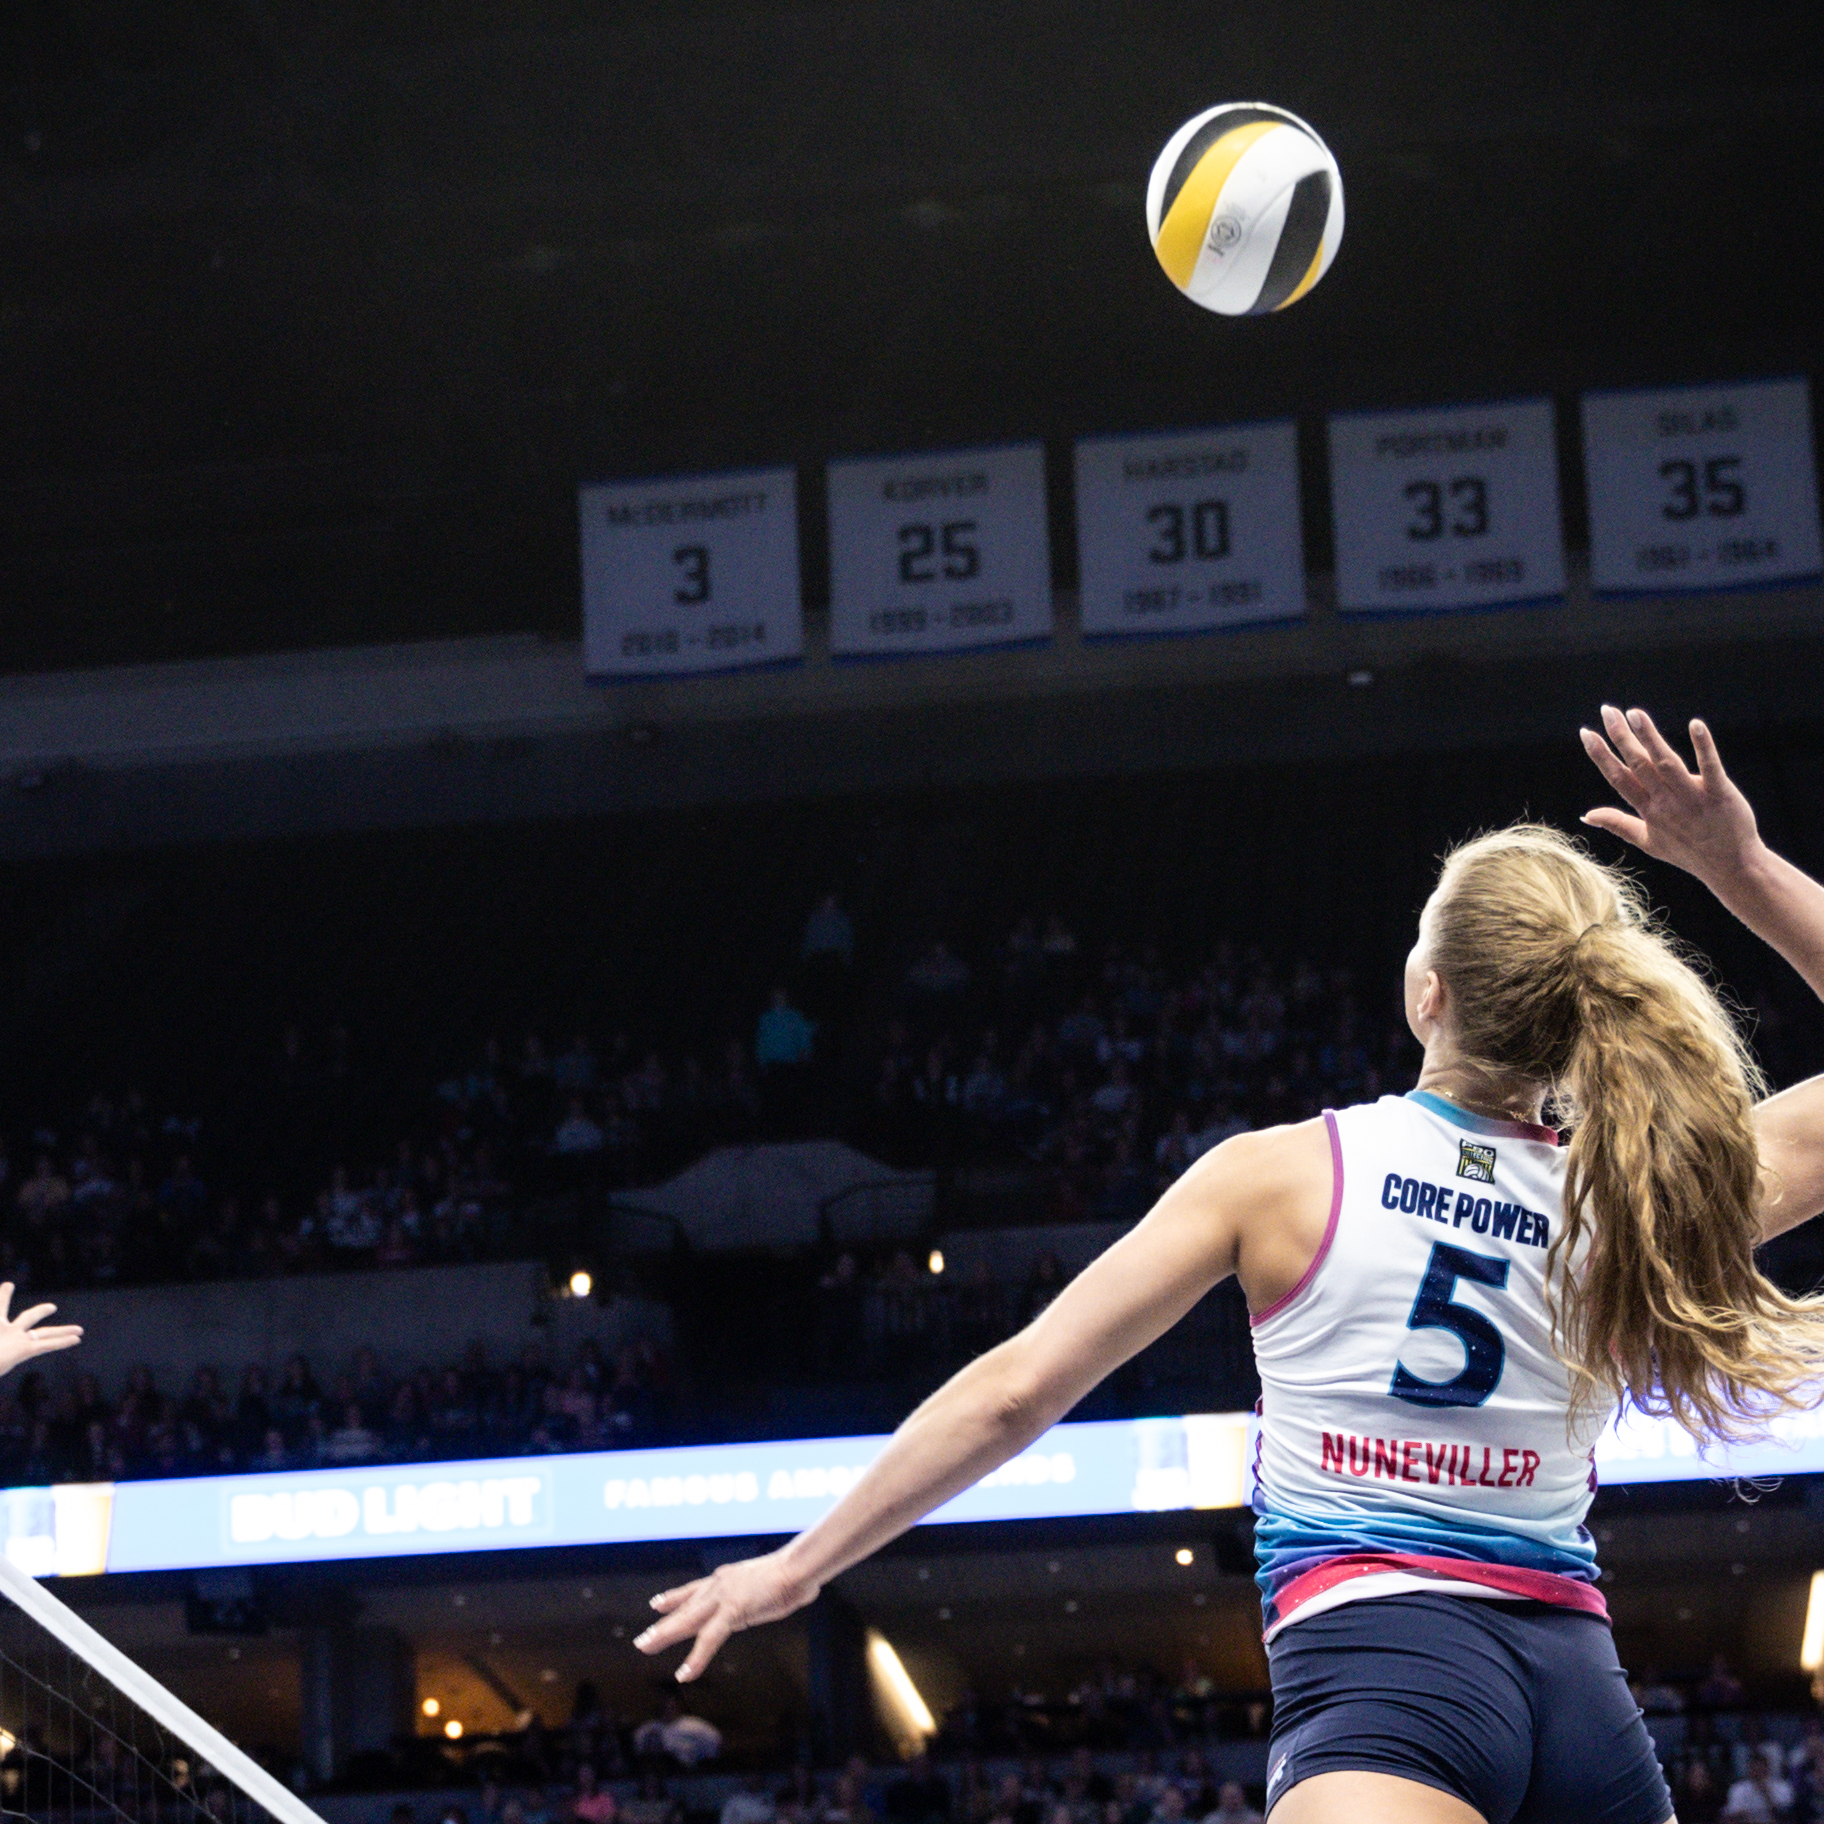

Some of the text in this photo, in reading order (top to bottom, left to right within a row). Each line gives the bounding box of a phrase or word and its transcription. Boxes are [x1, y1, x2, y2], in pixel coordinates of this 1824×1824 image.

[1405, 475, 1488, 542] 33
[1659, 456, 1745, 522] 35
[896, 519, 981, 584] 25
[1144, 499, 1229, 566] 30
[673, 543, 712, 606] 3
[1380, 1172, 1551, 1250] CORE POWER
[1386, 1239, 1511, 1409] 5
[1320, 1431, 1541, 1488] NUNEVILLER
[230, 1475, 542, 1543] BUD LIGHT
